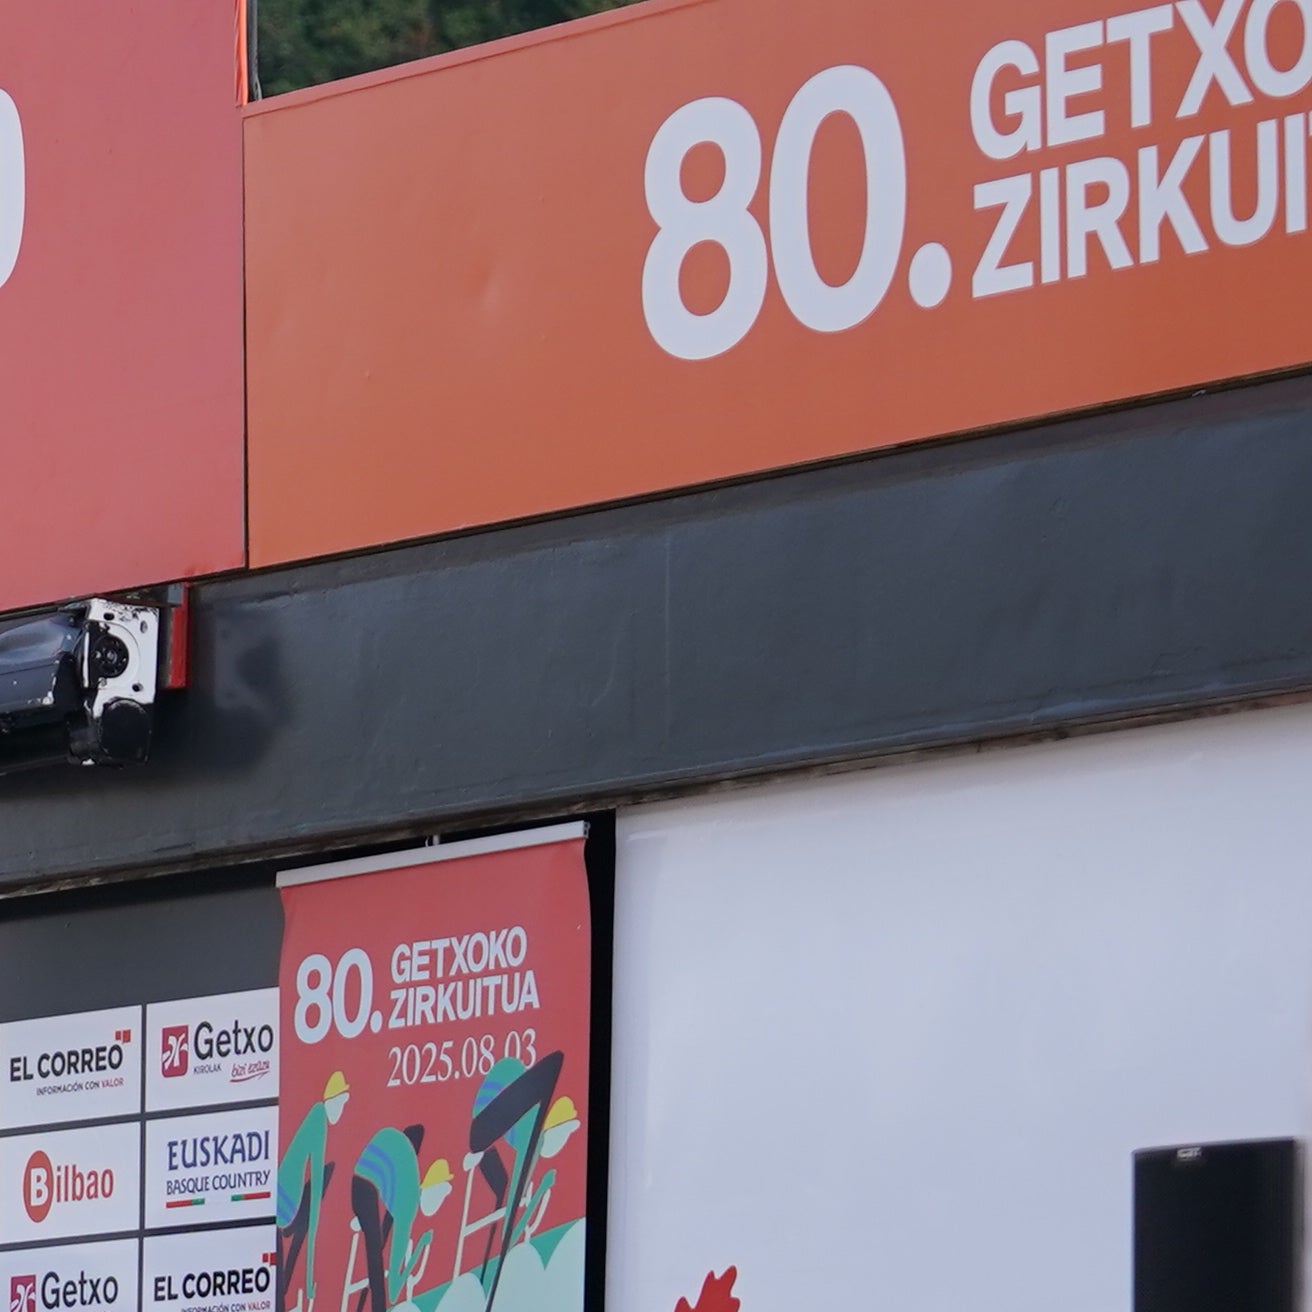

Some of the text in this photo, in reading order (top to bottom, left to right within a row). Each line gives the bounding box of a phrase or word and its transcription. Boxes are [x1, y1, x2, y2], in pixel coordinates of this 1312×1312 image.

[642, 64, 953, 360] 80.
[971, 111, 1312, 299] ZIRKUI
[294, 926, 528, 1044] 80. GETXOKO
[388, 970, 540, 1029] ZIRKUITUA
[193, 1020, 274, 1060] Getxo
[387, 1028, 537, 1087] 2025.0803
[10, 1044, 123, 1082] EL CORREO
[193, 1063, 222, 1075] KIROLAK
[36, 1077, 124, 1096] INFORMACIÓN CON VALOR
[167, 1130, 270, 1171] EUSKADI
[30, 1164, 114, 1207] Bilbao
[166, 1169, 271, 1196] BASQUE COUNTRY
[41, 1270, 119, 1310] Getxo
[154, 1267, 270, 1301] EL CORREO
[230, 1303, 247, 1312] CON
[247, 1300, 271, 1312] VALOR
